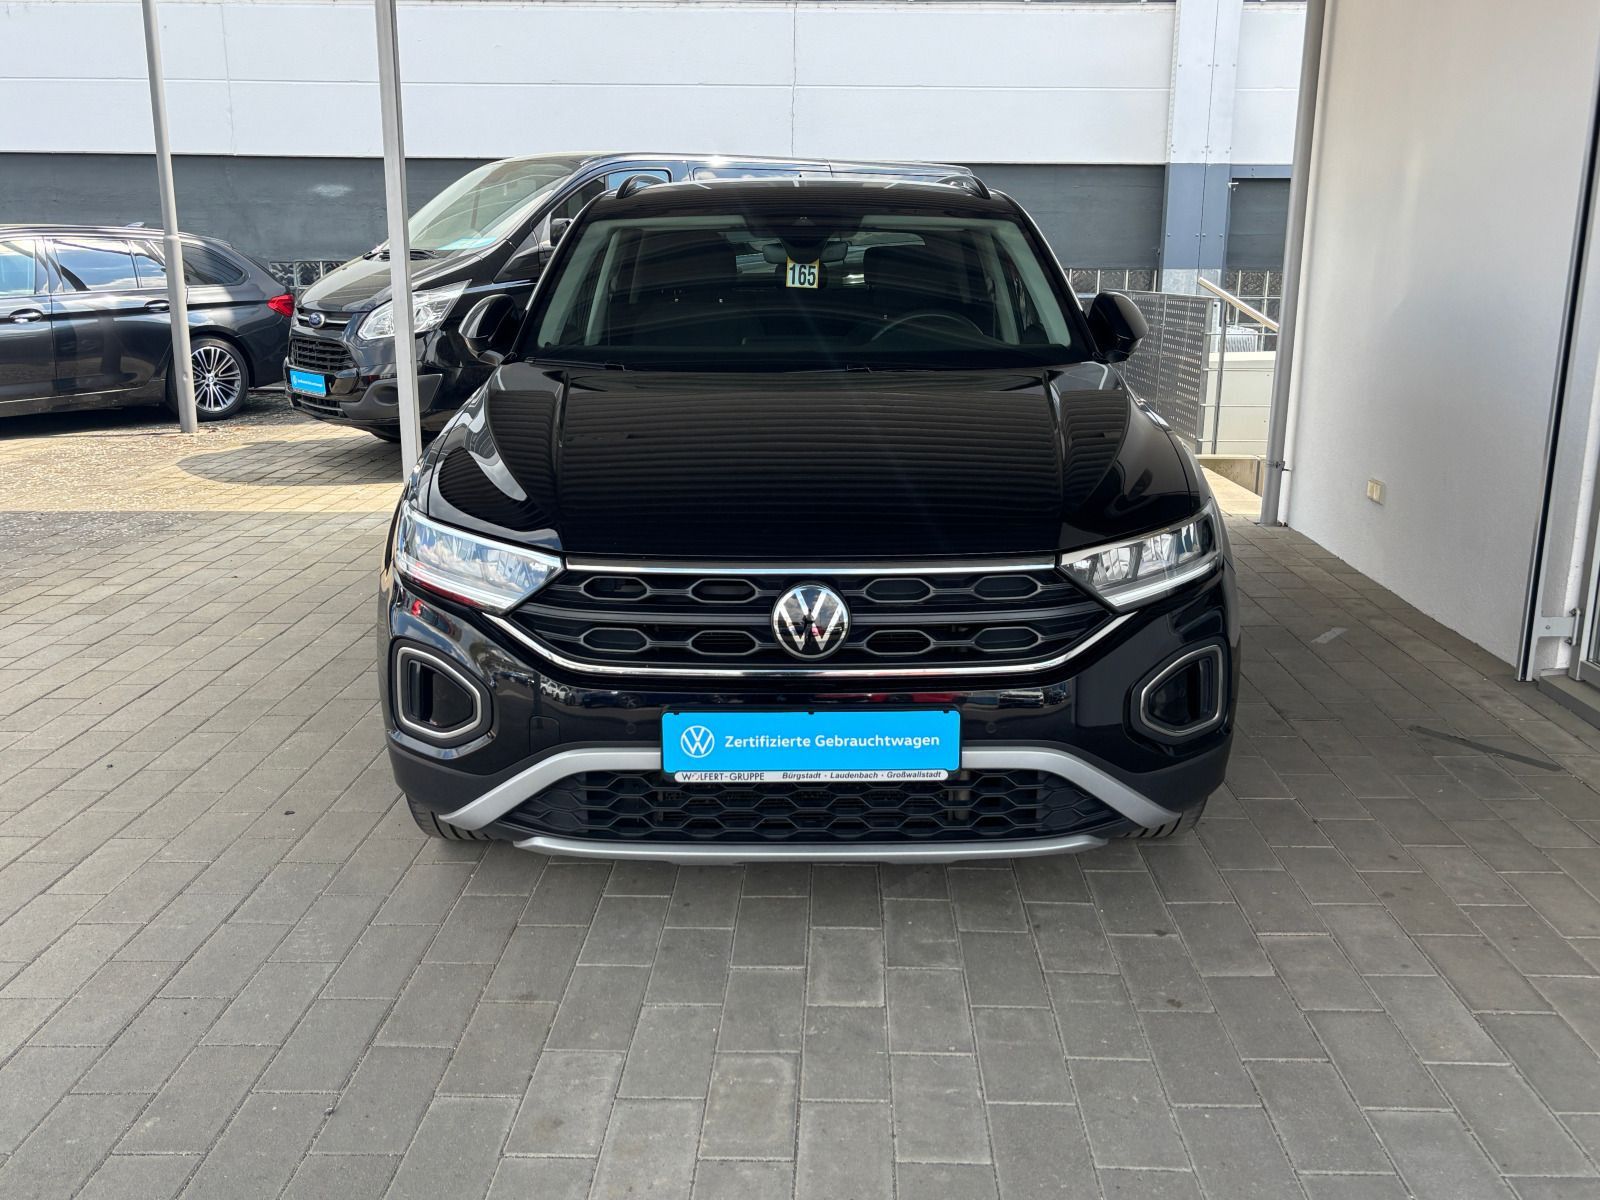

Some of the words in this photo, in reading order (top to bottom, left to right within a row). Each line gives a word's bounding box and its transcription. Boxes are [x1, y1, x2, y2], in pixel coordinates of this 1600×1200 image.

[789, 264, 816, 286] 165
[725, 735, 811, 748] Zertifizierte
[815, 734, 940, 748] Gebrauchtwagen
[782, 772, 821, 780] Bürgstadt
[830, 771, 879, 779] Laudenbach
